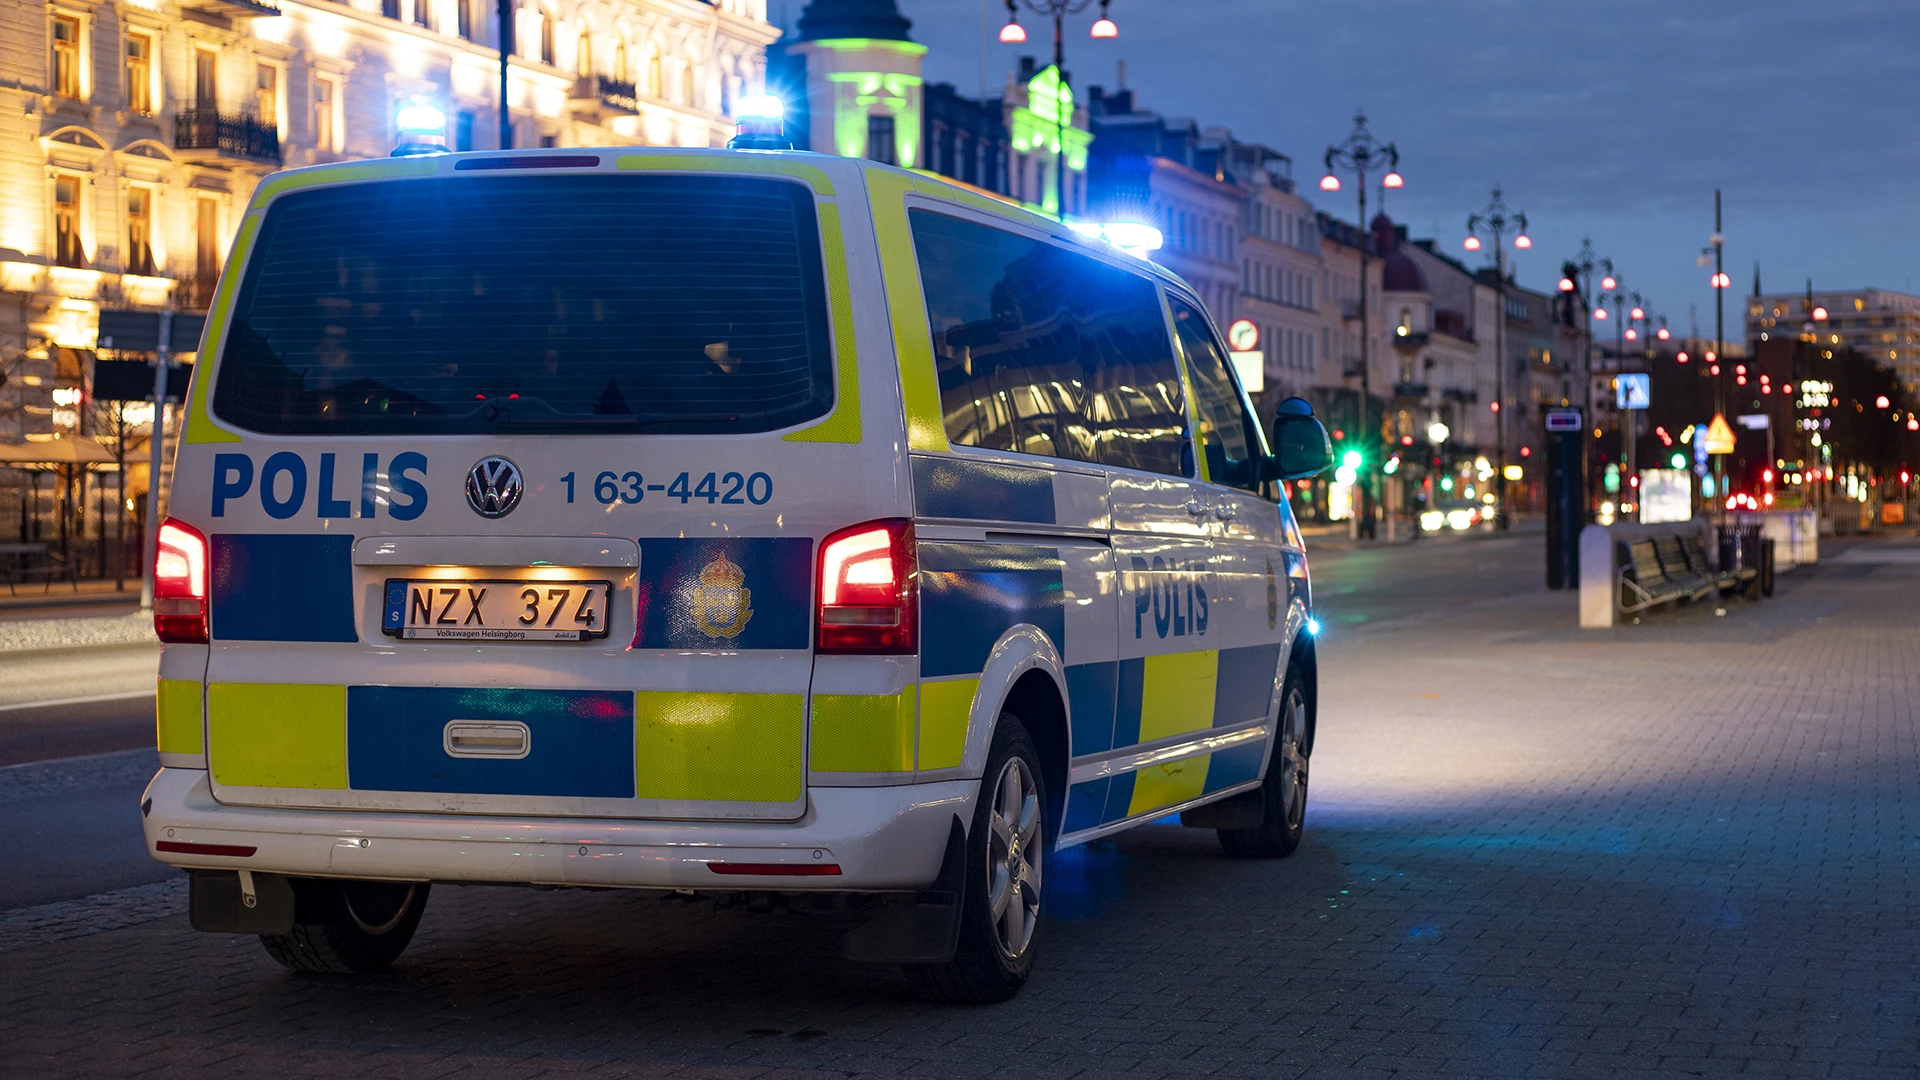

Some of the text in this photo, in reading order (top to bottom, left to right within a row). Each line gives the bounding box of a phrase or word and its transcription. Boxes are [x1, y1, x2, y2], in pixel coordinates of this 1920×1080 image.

[211, 451, 428, 521] POLIS
[560, 471, 773, 505] 1 63-4420
[411, 587, 595, 626] NZX 374
[1131, 555, 1209, 639] POLIS
[392, 611, 400, 621] S
[437, 629, 479, 638] Volkswagen
[481, 630, 526, 639] Helsingborg
